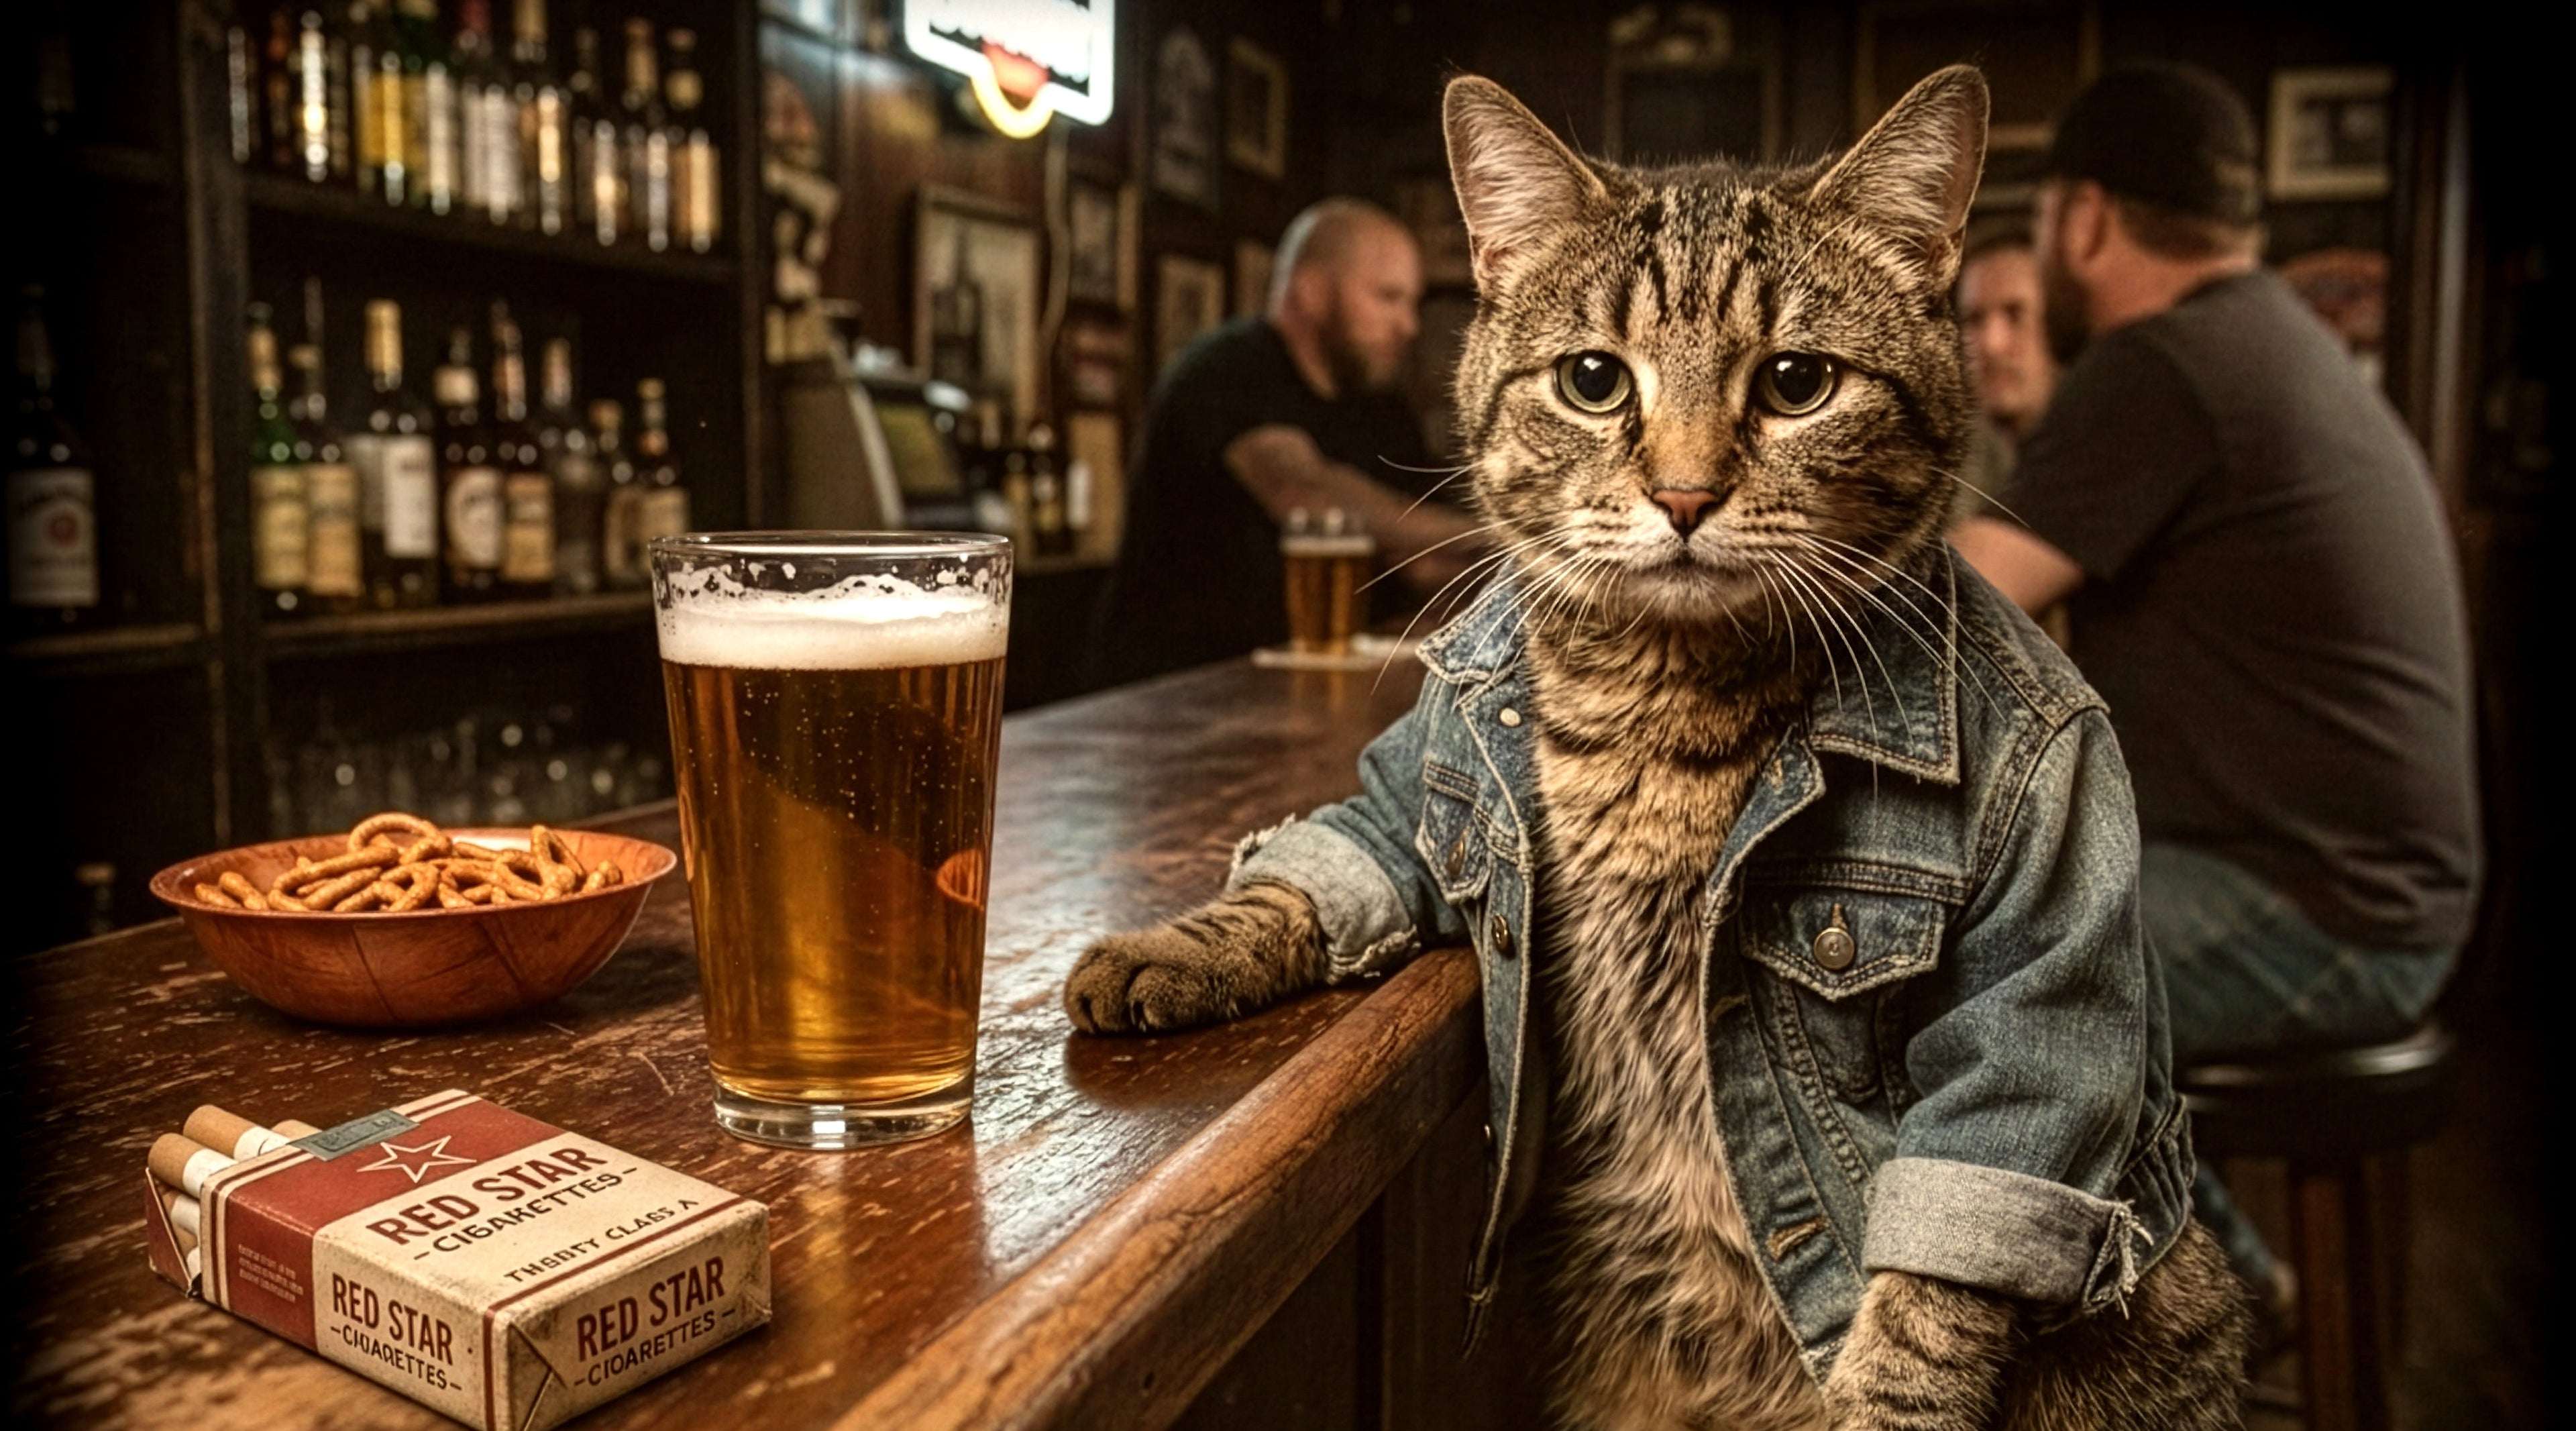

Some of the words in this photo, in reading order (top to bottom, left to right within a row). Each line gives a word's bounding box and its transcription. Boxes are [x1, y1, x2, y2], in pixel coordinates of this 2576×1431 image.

[366, 1194, 481, 1245] RED
[472, 1148, 608, 1201] STAR
[333, 1271, 380, 1330] RED
[388, 1299, 453, 1366] STAR
[577, 1295, 639, 1363] RED
[649, 1255, 725, 1327] STAR
